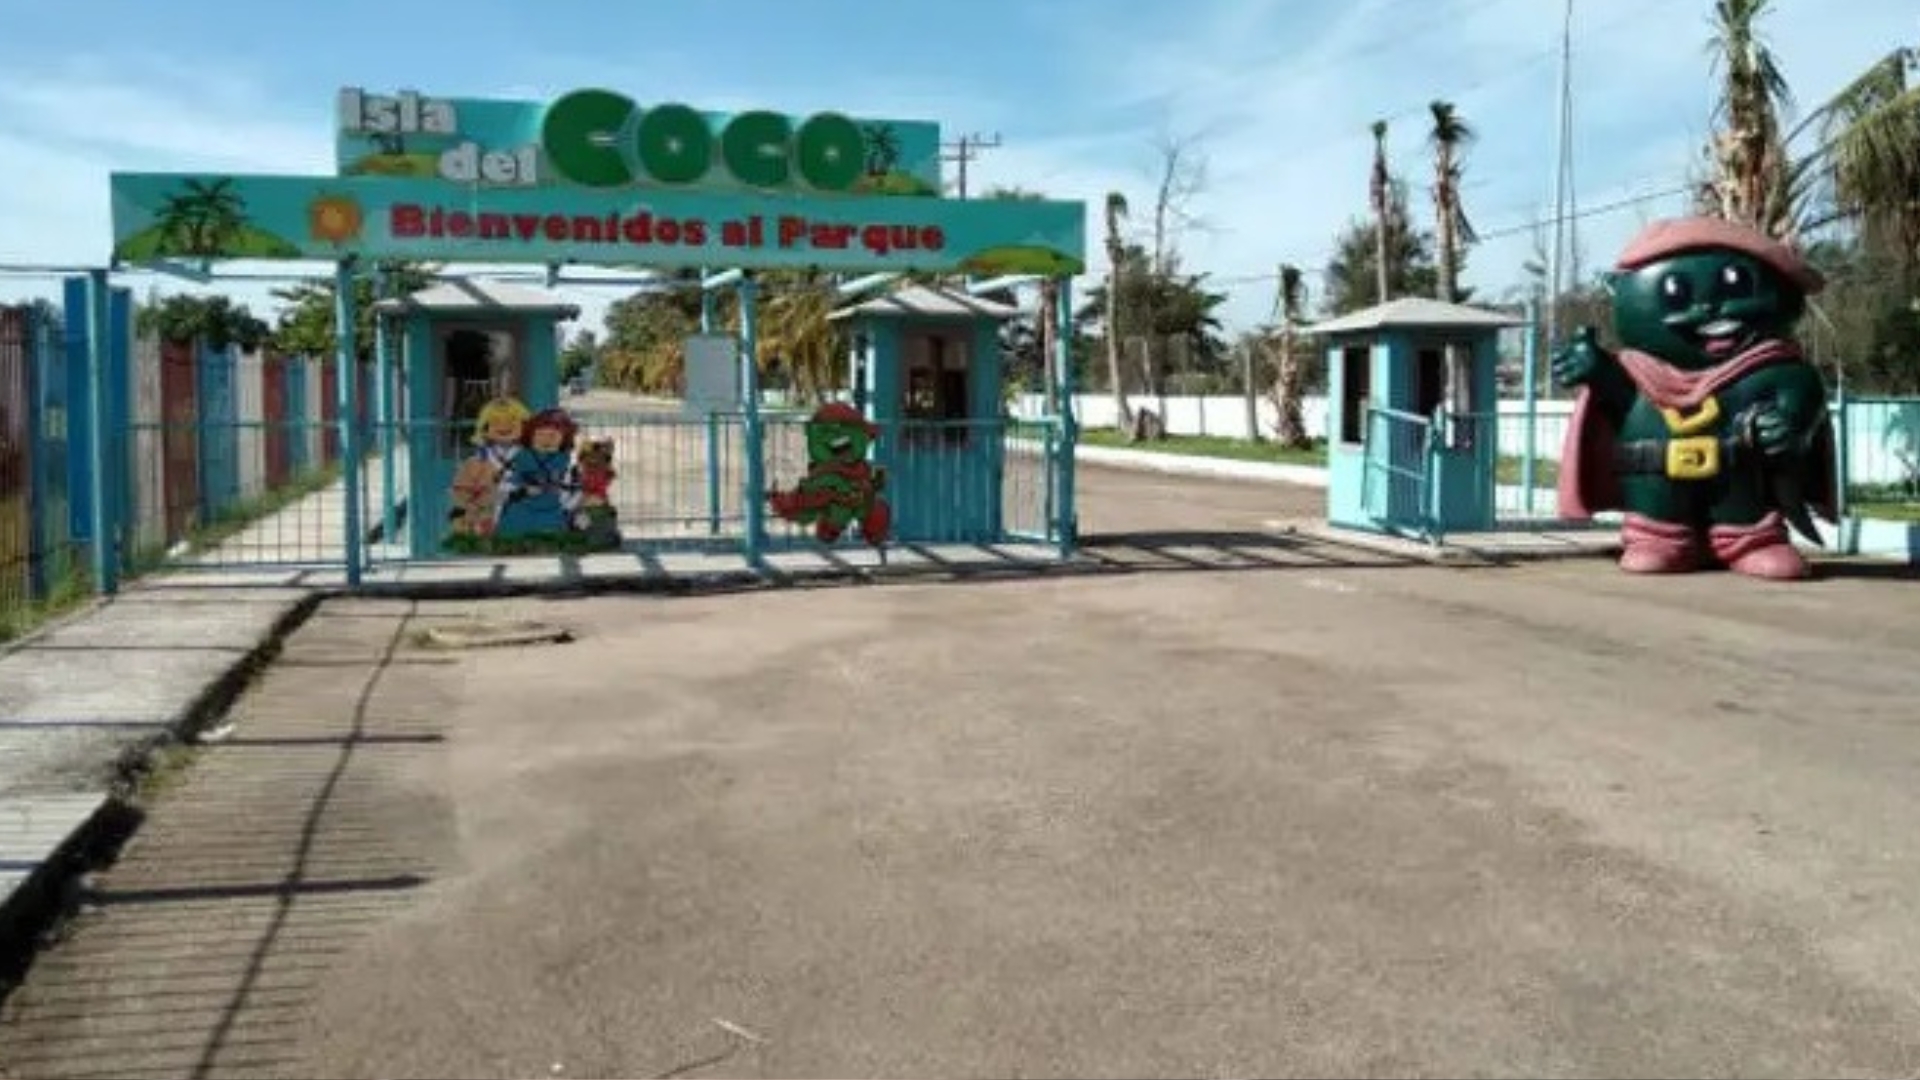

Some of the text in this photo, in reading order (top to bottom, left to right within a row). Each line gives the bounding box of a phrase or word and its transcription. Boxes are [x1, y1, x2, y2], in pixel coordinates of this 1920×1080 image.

[340, 87, 455, 133] Isla
[438, 142, 537, 183] del
[391, 204, 944, 254] Bienvenidos al Parque
